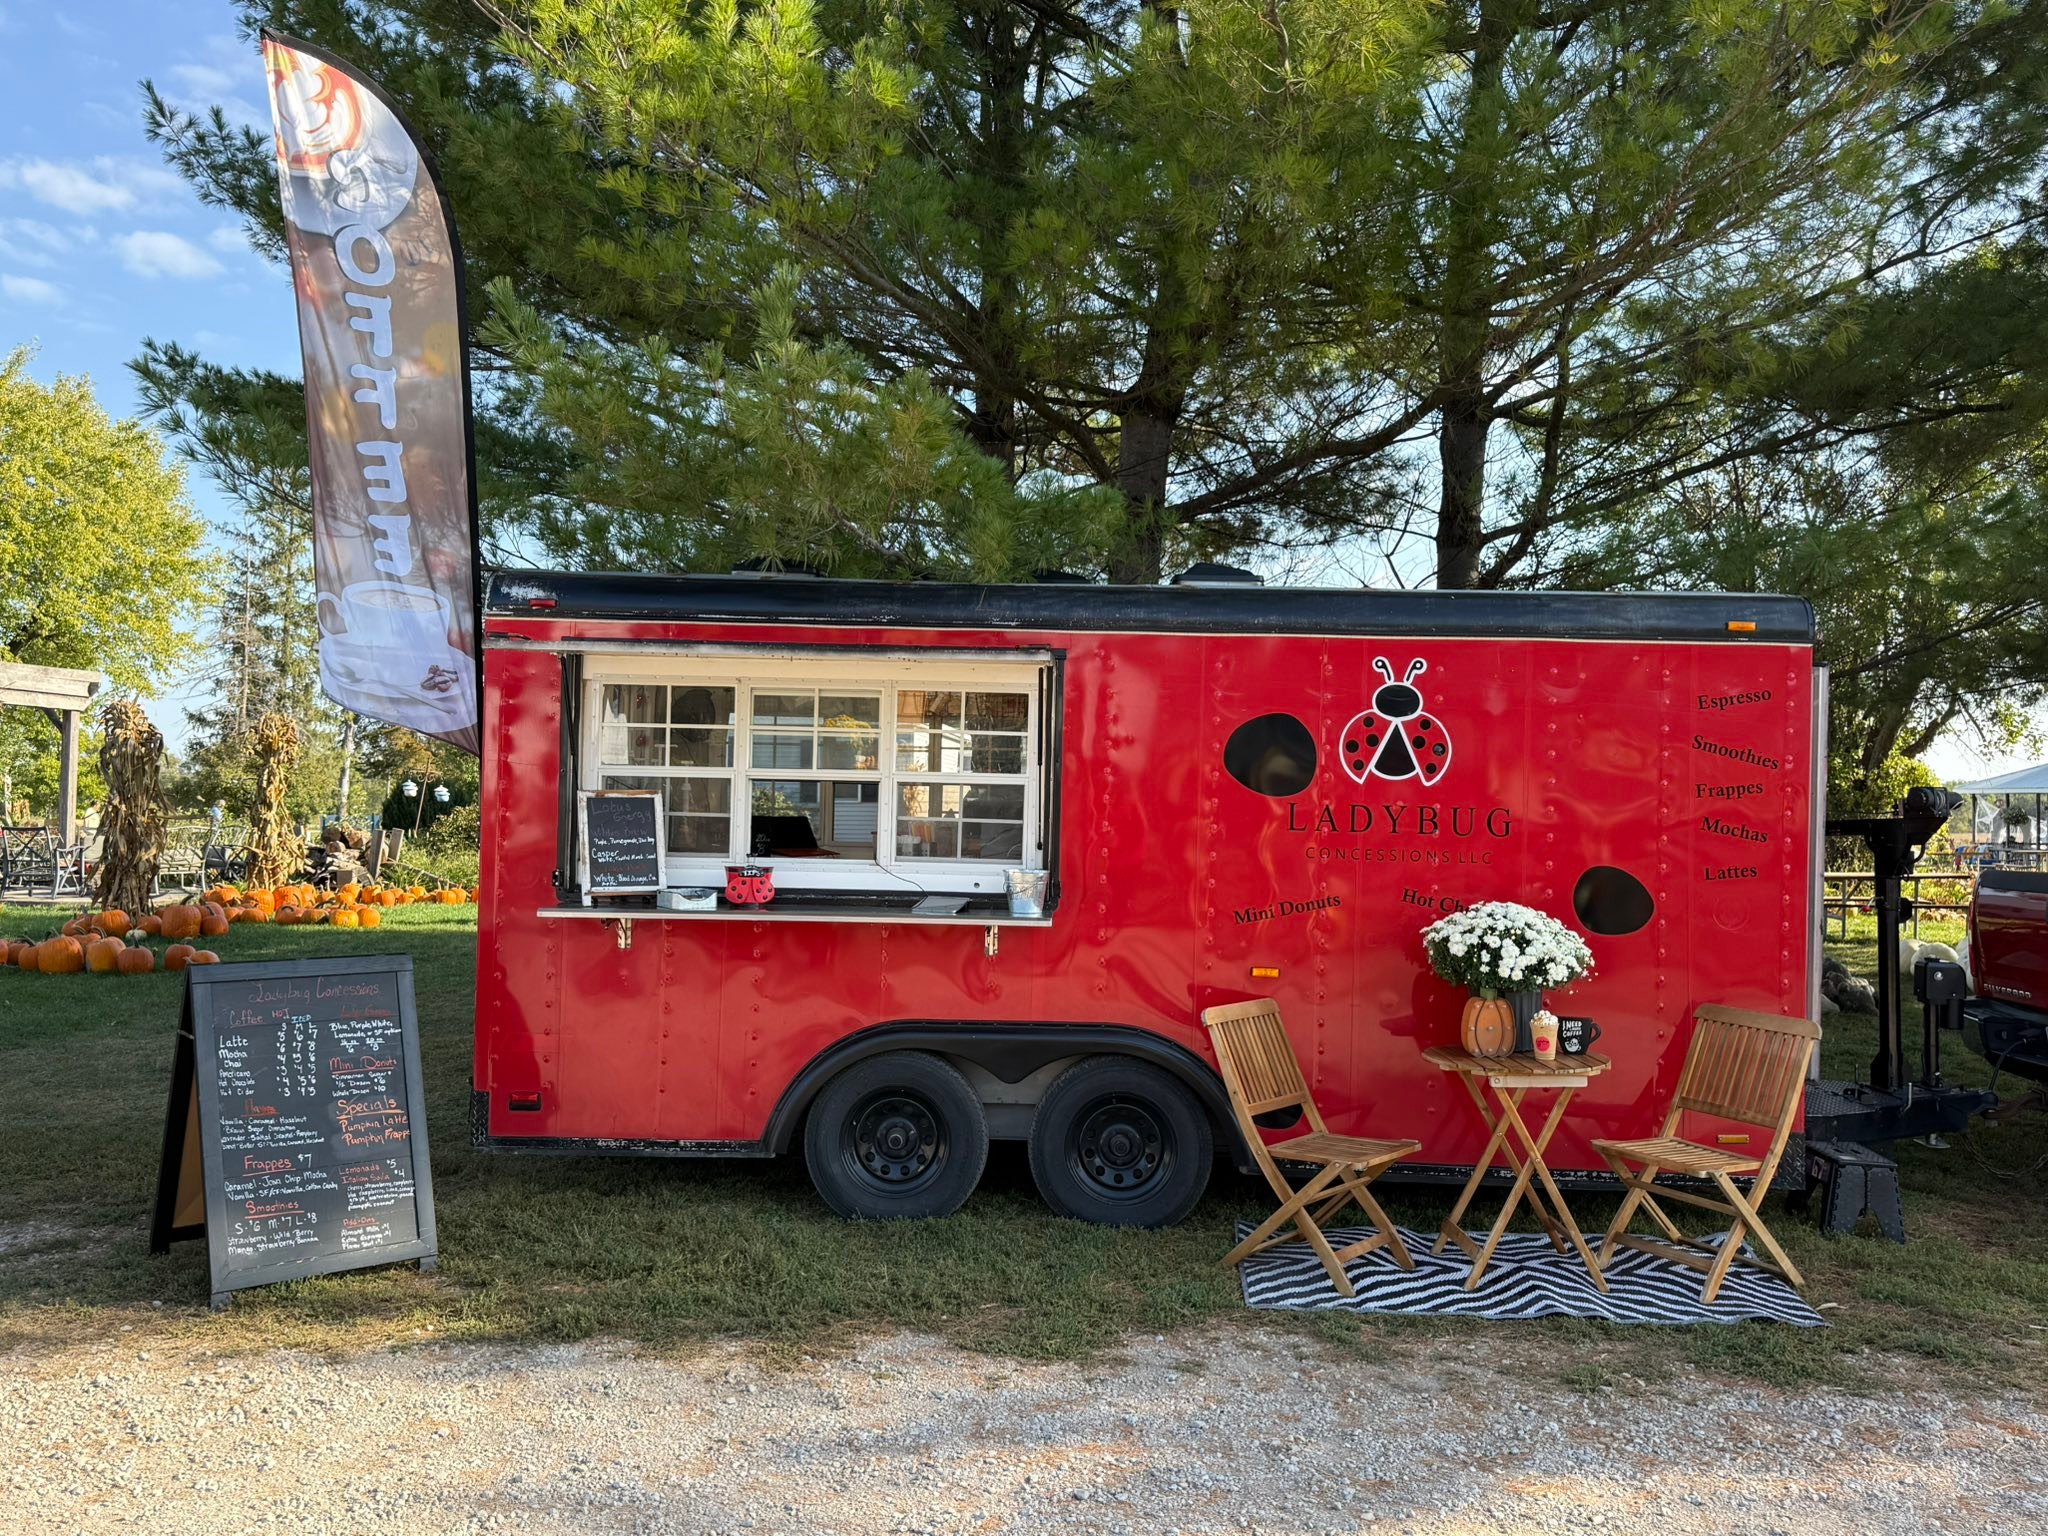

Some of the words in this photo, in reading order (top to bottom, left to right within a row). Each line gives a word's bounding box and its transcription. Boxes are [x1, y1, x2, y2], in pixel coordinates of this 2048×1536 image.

[1697, 689, 1772, 710] Espresso
[1692, 735, 1779, 770] Smoothies
[1695, 783, 1763, 799] Frappes
[1288, 802, 1512, 838] LADYBUG
[1701, 816, 1768, 842] Mochas
[1305, 847, 1450, 864] CONCESSIONS
[1458, 851, 1492, 865] LLC
[1704, 866, 1758, 881] Lattes
[1402, 888, 1434, 908] Hot
[1233, 904, 1275, 924] Mini
[1279, 895, 1341, 917] Donuts
[229, 1008, 264, 1025] Coffee
[281, 1022, 288, 1031] S
[295, 1022, 304, 1031] M
[219, 1035, 249, 1048] Latte
[218, 1049, 248, 1059] Mocha
[223, 1059, 242, 1068] Chai
[329, 1056, 354, 1071] Mini
[360, 1055, 397, 1070] Donuts
[336, 1095, 397, 1117] Specials
[339, 1119, 381, 1132] Pumpkin
[382, 1115, 408, 1125] Latte
[243, 1154, 292, 1172] Frappes
[297, 1153, 312, 1168] $7
[338, 1163, 380, 1175] Lemonade
[223, 1178, 257, 1192] Caramel
[303, 1170, 328, 1180] Mocha
[245, 1200, 299, 1214] Smoothies
